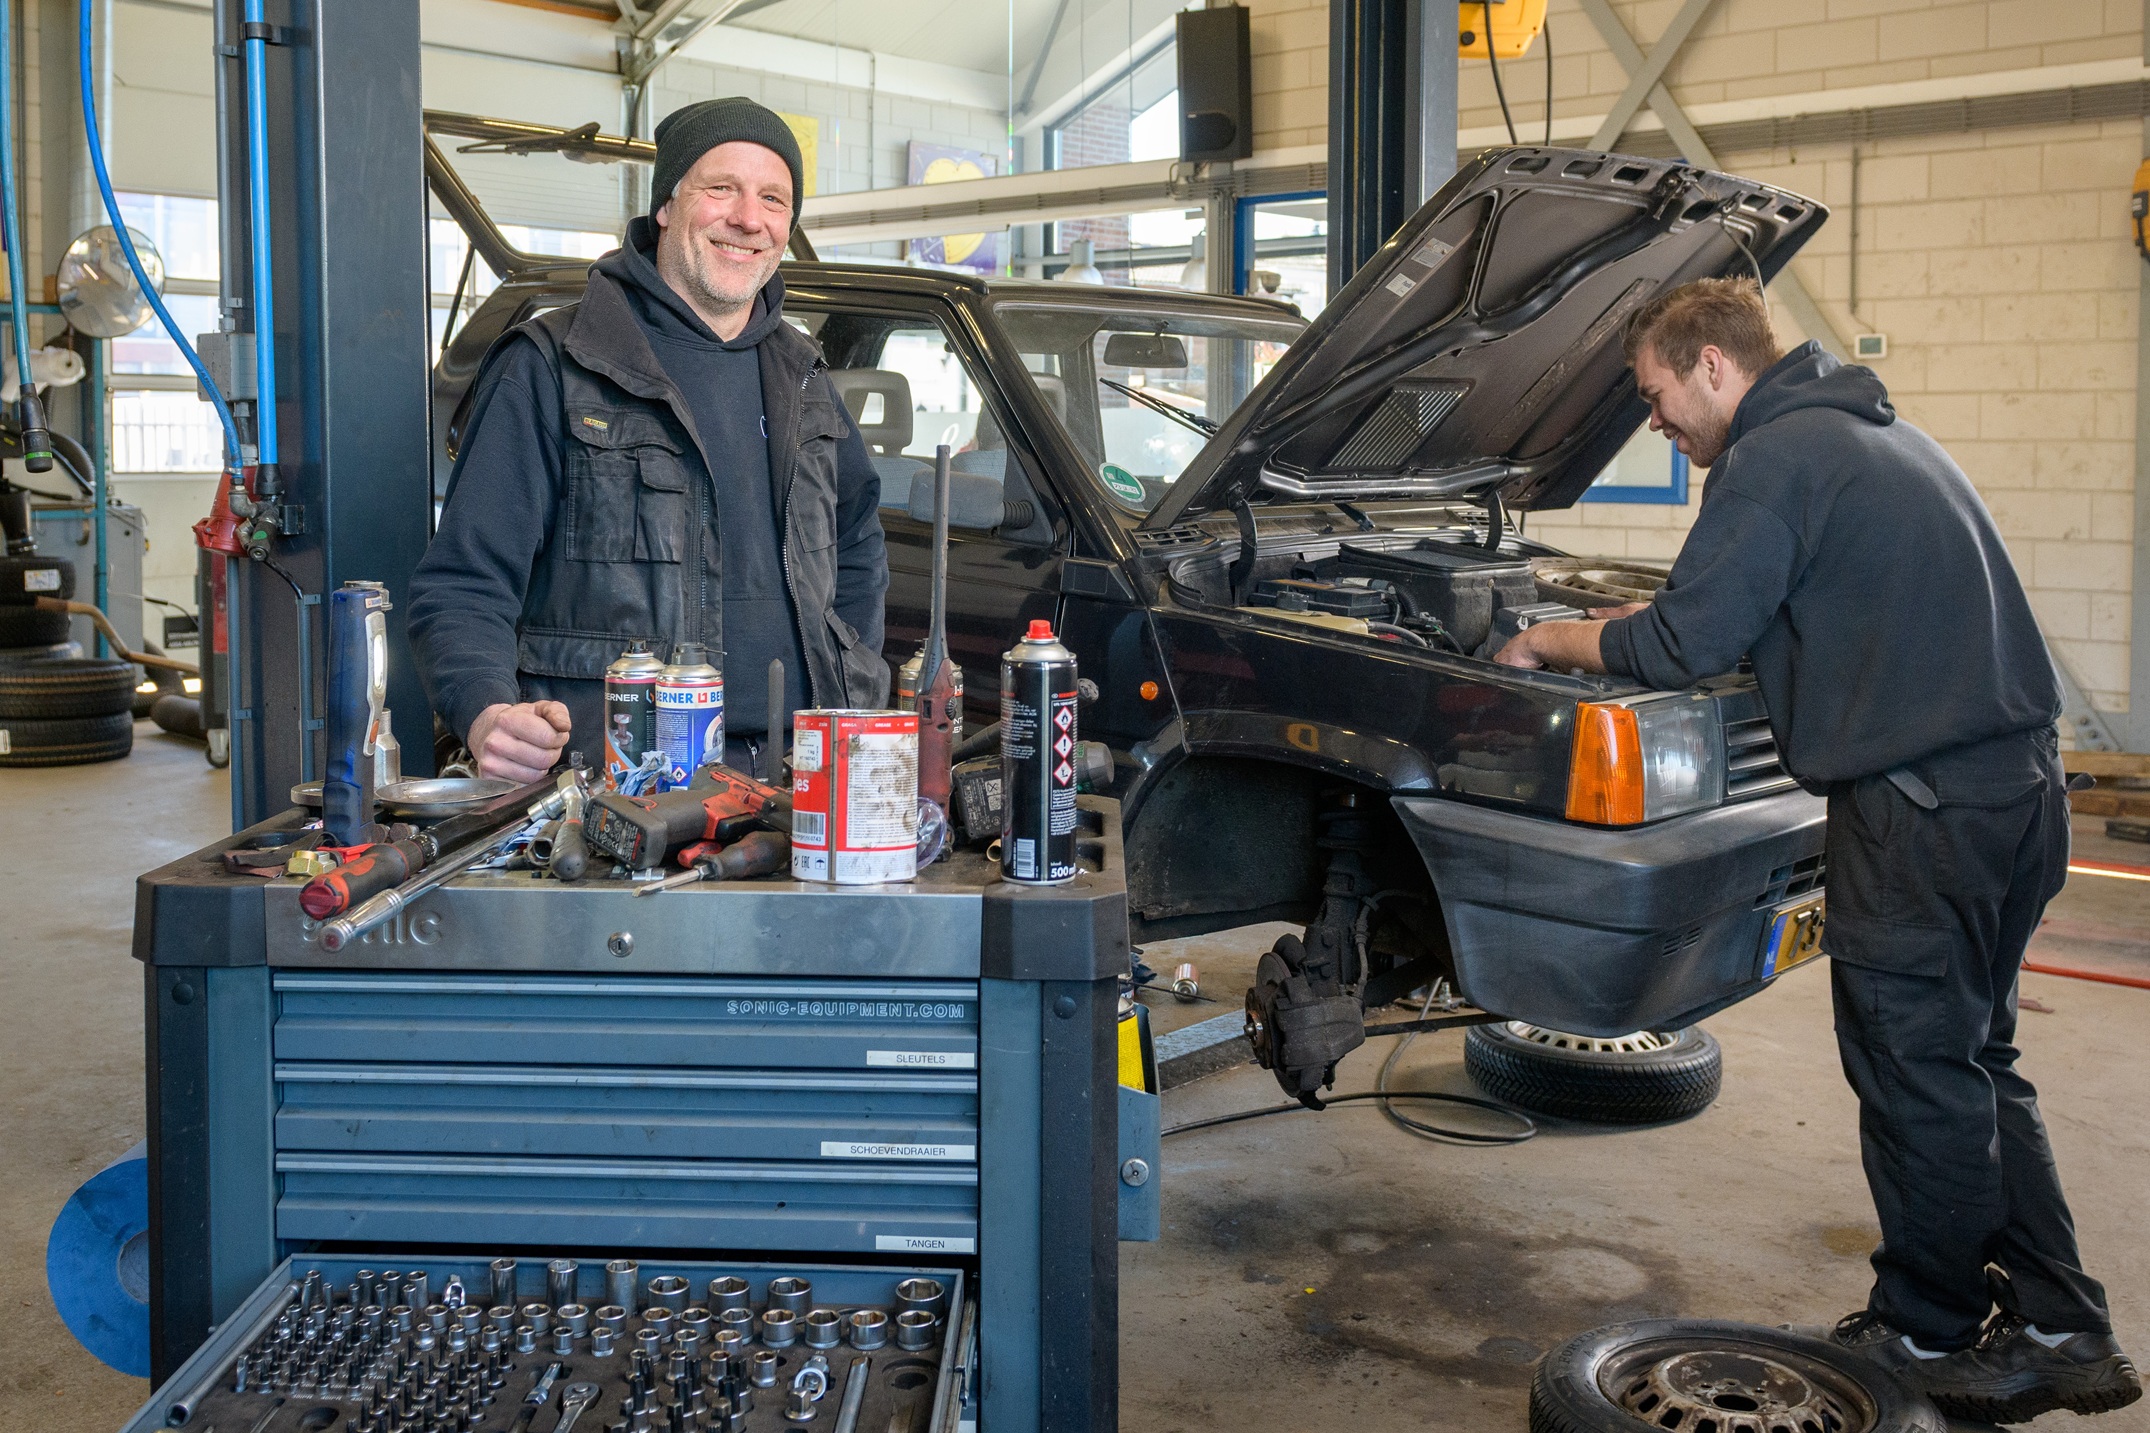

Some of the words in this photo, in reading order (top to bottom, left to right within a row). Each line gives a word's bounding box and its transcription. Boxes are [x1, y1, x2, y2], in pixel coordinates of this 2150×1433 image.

[727, 1000, 965, 1018] SONIC-EQUIPMENT.COM
[896, 1053, 946, 1064] SLEUTELS
[850, 1145, 946, 1156] SCHOEVENDRAAIER
[905, 1239, 945, 1249] TANGEN
